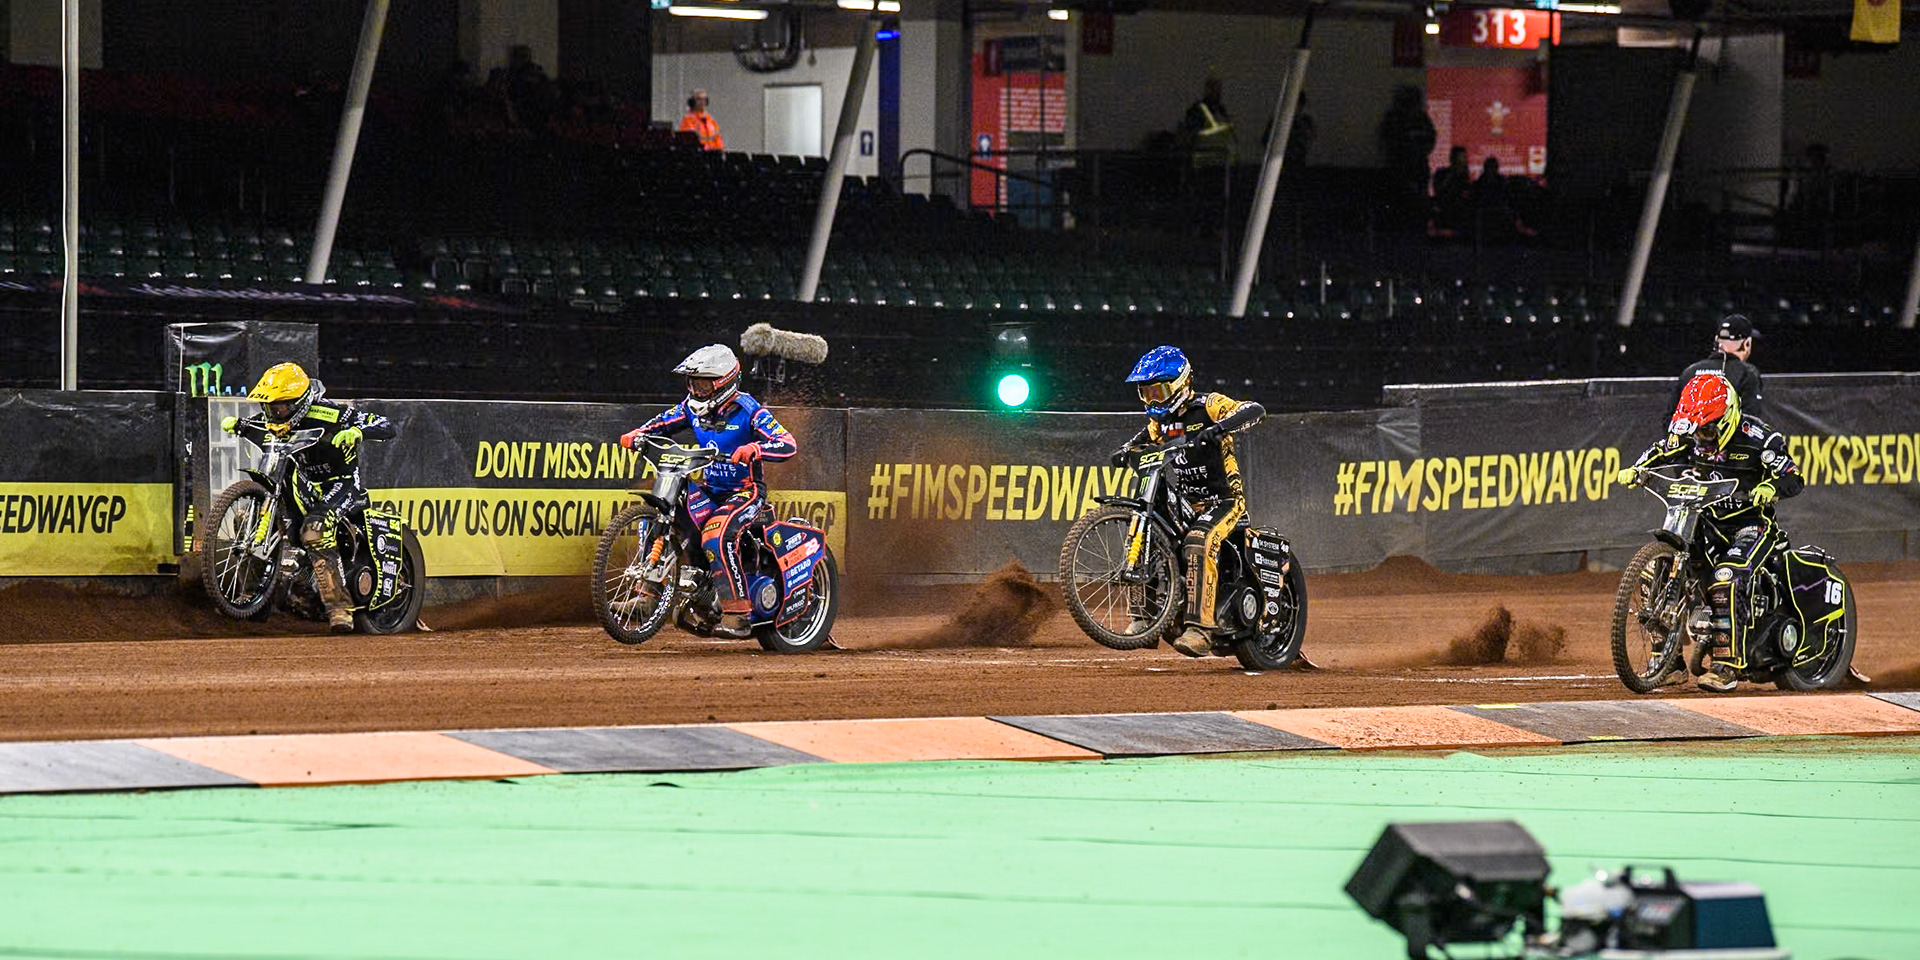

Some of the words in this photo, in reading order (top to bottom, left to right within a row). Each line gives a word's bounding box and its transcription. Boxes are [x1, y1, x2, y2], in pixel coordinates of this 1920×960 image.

[1473, 9, 1526, 45] 313
[1186, 423, 1204, 432] SGP
[475, 441, 541, 478] DONT
[543, 442, 593, 479] MISS
[594, 442, 640, 479] ANY
[1788, 433, 1920, 486] FIMSPEED
[1334, 447, 1620, 515] #FIMSPEEDWAYGP
[0, 495, 126, 534] EDWAYGP
[389, 519, 401, 532] 54
[465, 500, 489, 536] US
[493, 500, 528, 536] ON
[1825, 581, 1843, 604] 16
